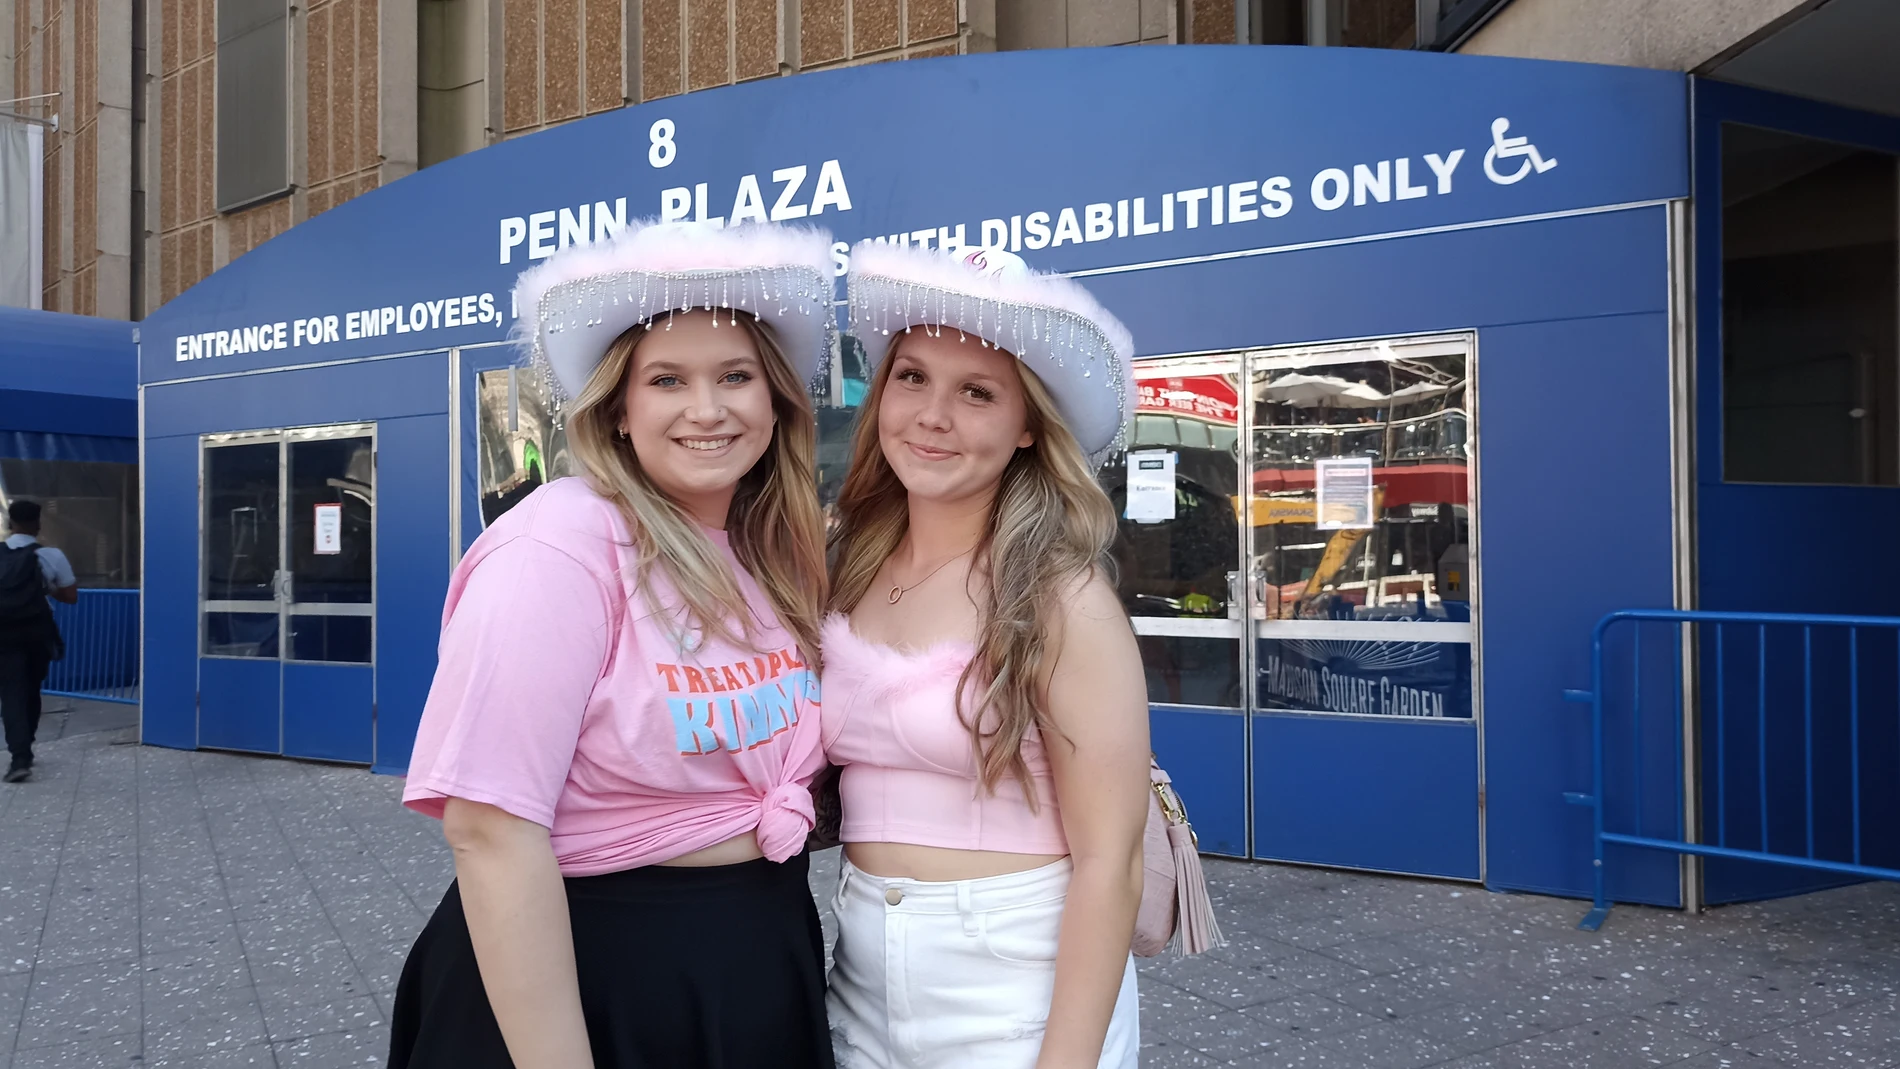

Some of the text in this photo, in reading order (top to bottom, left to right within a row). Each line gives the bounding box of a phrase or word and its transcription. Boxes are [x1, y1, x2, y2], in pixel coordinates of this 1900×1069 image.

[648, 118, 677, 169] 8
[500, 159, 852, 265] PENN PLAZA
[176, 321, 288, 362] ENTRANCE
[293, 314, 339, 347] FOR
[345, 292, 503, 340] EMPLOYEES,
[981, 176, 1293, 254] DISABILITIES
[1310, 149, 1466, 211] ONLY
[656, 661, 756, 693] TREAT
[1267, 655, 1443, 718] MADISON SQUARE GARDEN
